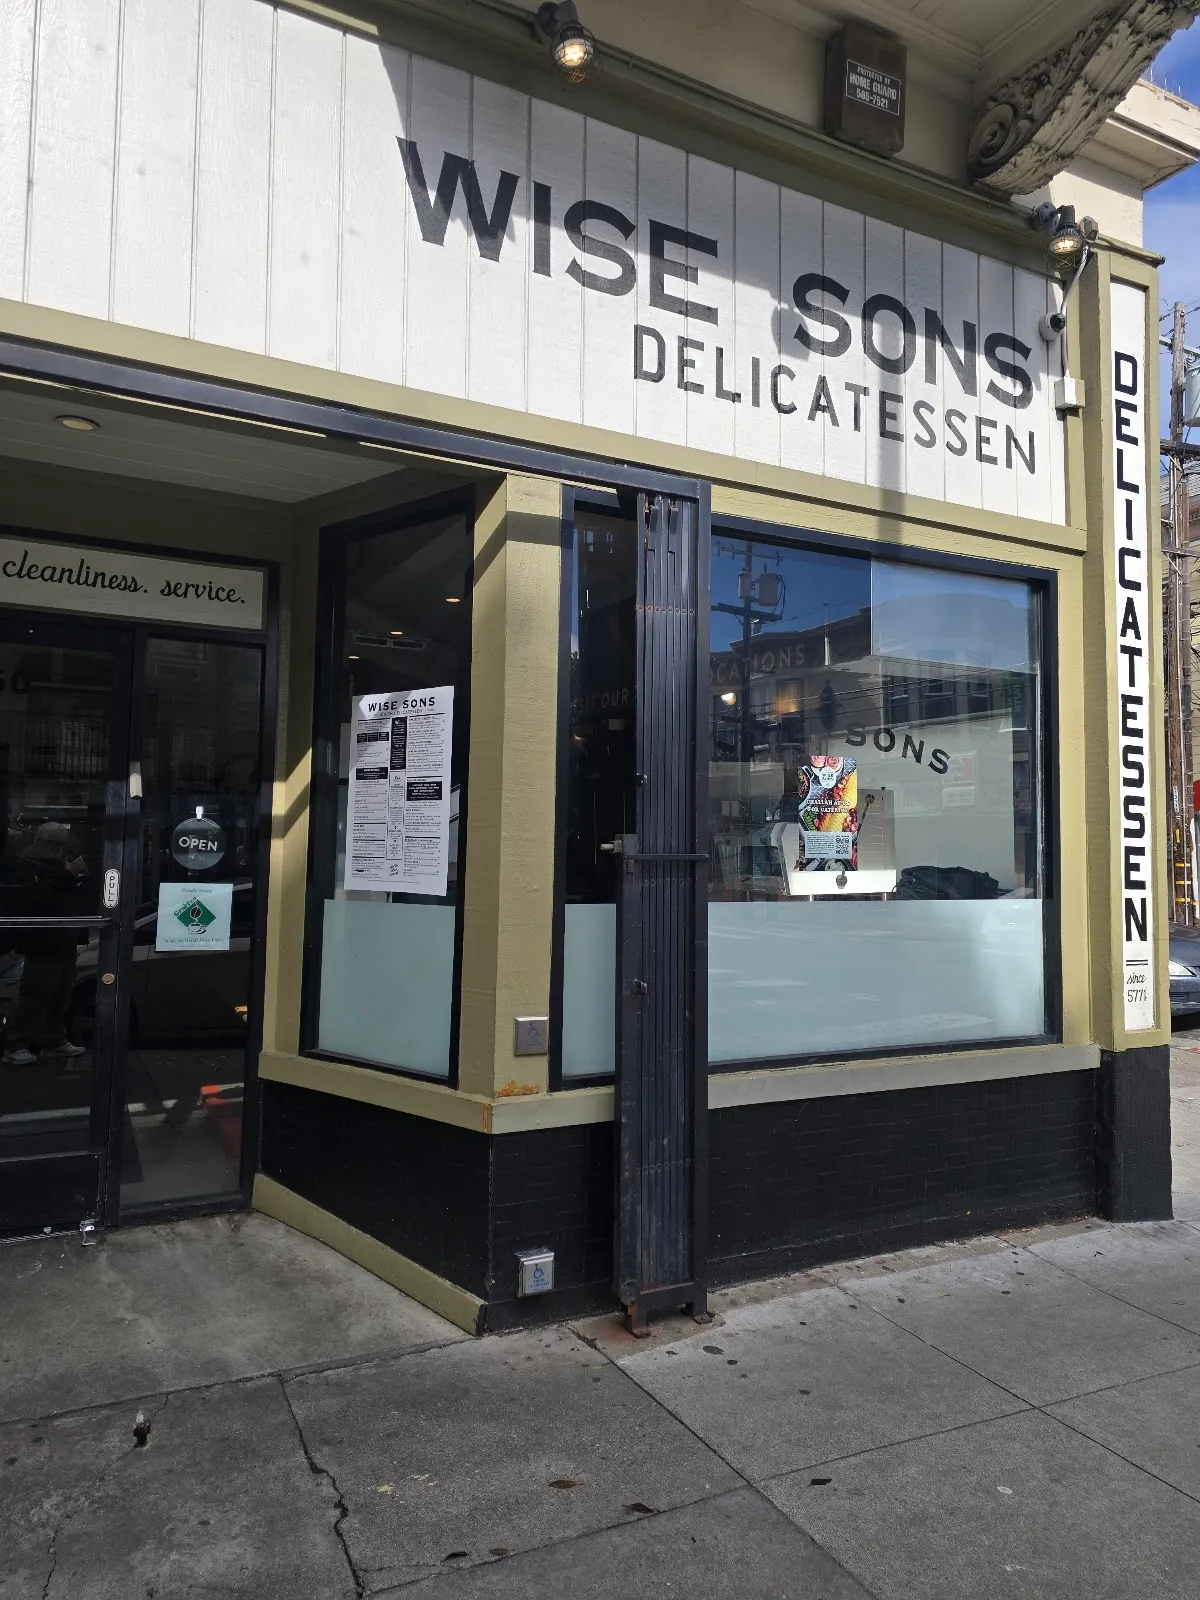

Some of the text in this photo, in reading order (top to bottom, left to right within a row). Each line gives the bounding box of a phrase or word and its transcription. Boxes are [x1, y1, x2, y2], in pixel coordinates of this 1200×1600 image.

[849, 72, 897, 100] HOME GUARD
[395, 136, 1034, 410] WISE SONS
[633, 323, 1036, 475] DELICATESSEN
[2, 550, 246, 604] cleanliness. service.
[1114, 350, 1148, 942] DELICATESSEN
[368, 696, 436, 712] WISE SONS
[845, 722, 951, 775] SONS
[178, 836, 218, 852] OPEN
[107, 876, 115, 902] PULL
[1126, 972, 1146, 985] since
